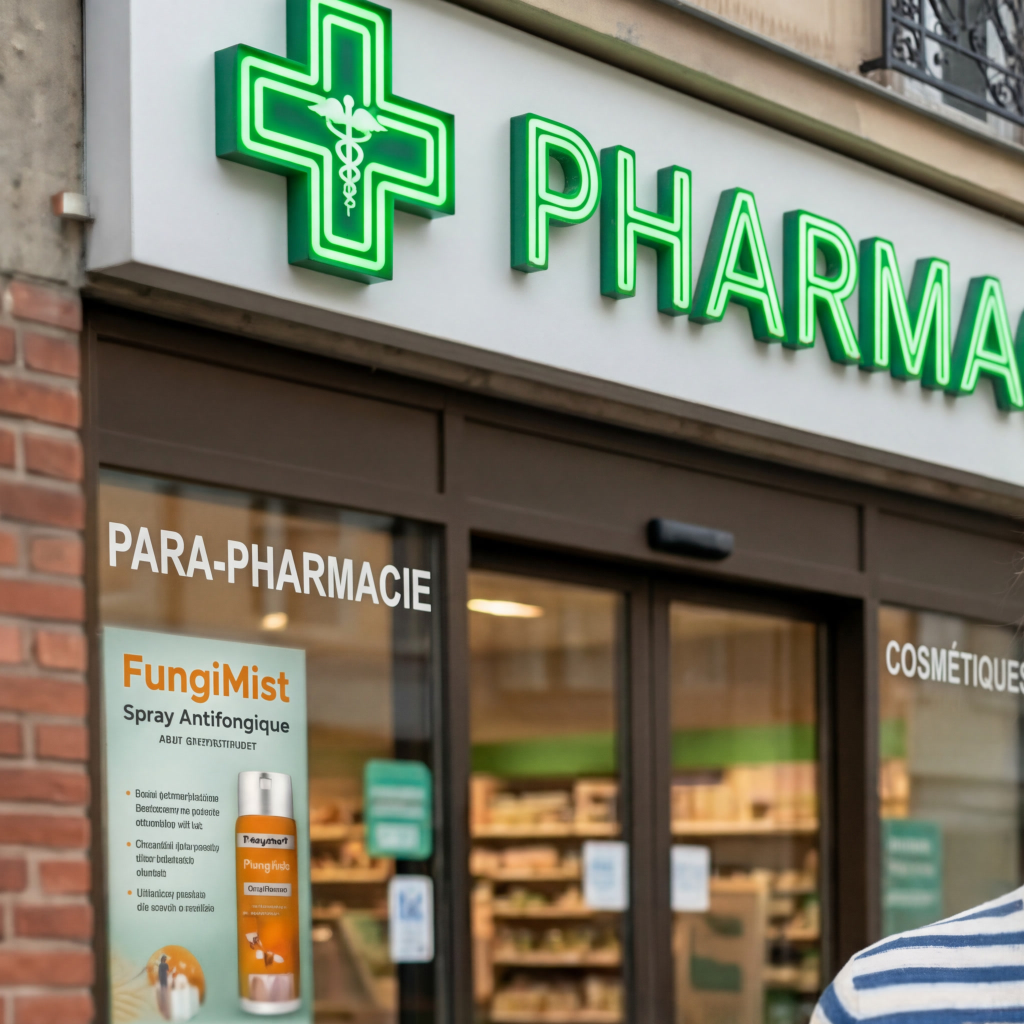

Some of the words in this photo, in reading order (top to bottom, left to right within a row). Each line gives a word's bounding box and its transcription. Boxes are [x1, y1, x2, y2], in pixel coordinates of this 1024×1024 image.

[108, 521, 432, 612] PARA-PHARMACIE
[123, 653, 290, 704] FungiMist
[123, 704, 175, 727] Spray
[179, 709, 290, 736] Antifongique
